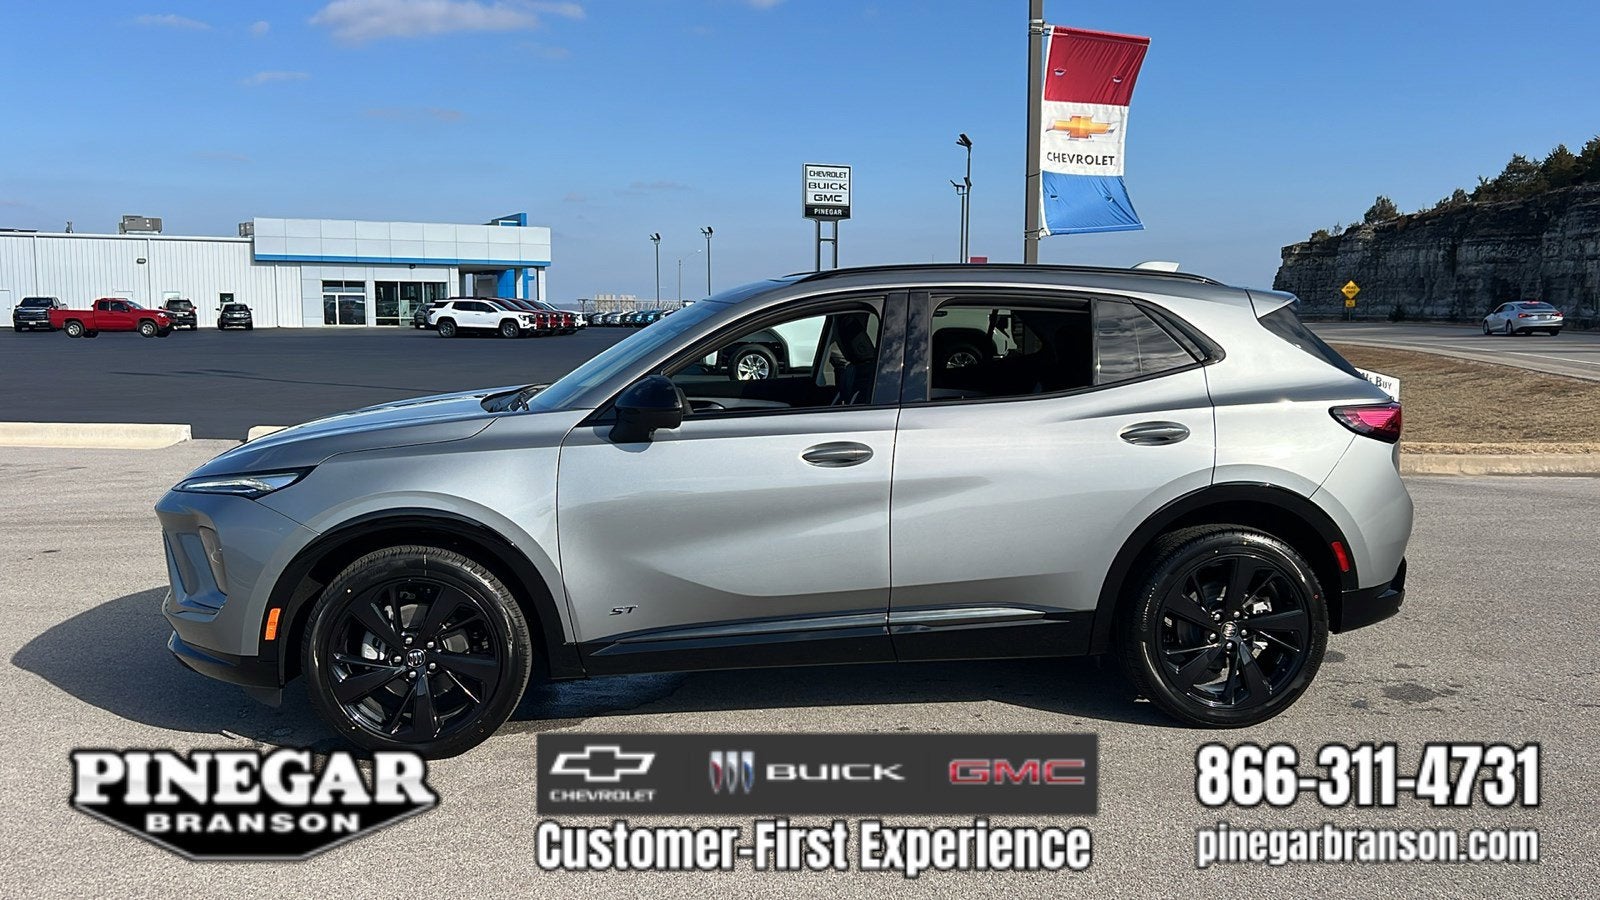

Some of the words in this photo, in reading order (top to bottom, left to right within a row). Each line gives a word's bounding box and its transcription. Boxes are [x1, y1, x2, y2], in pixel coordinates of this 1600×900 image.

[1047, 151, 1115, 166] CHEVROLET
[809, 170, 848, 179] CHEVROLET
[808, 181, 848, 191] BUICK
[813, 193, 843, 203] GMC
[814, 208, 843, 216] PINEGAR
[609, 605, 638, 616] ST
